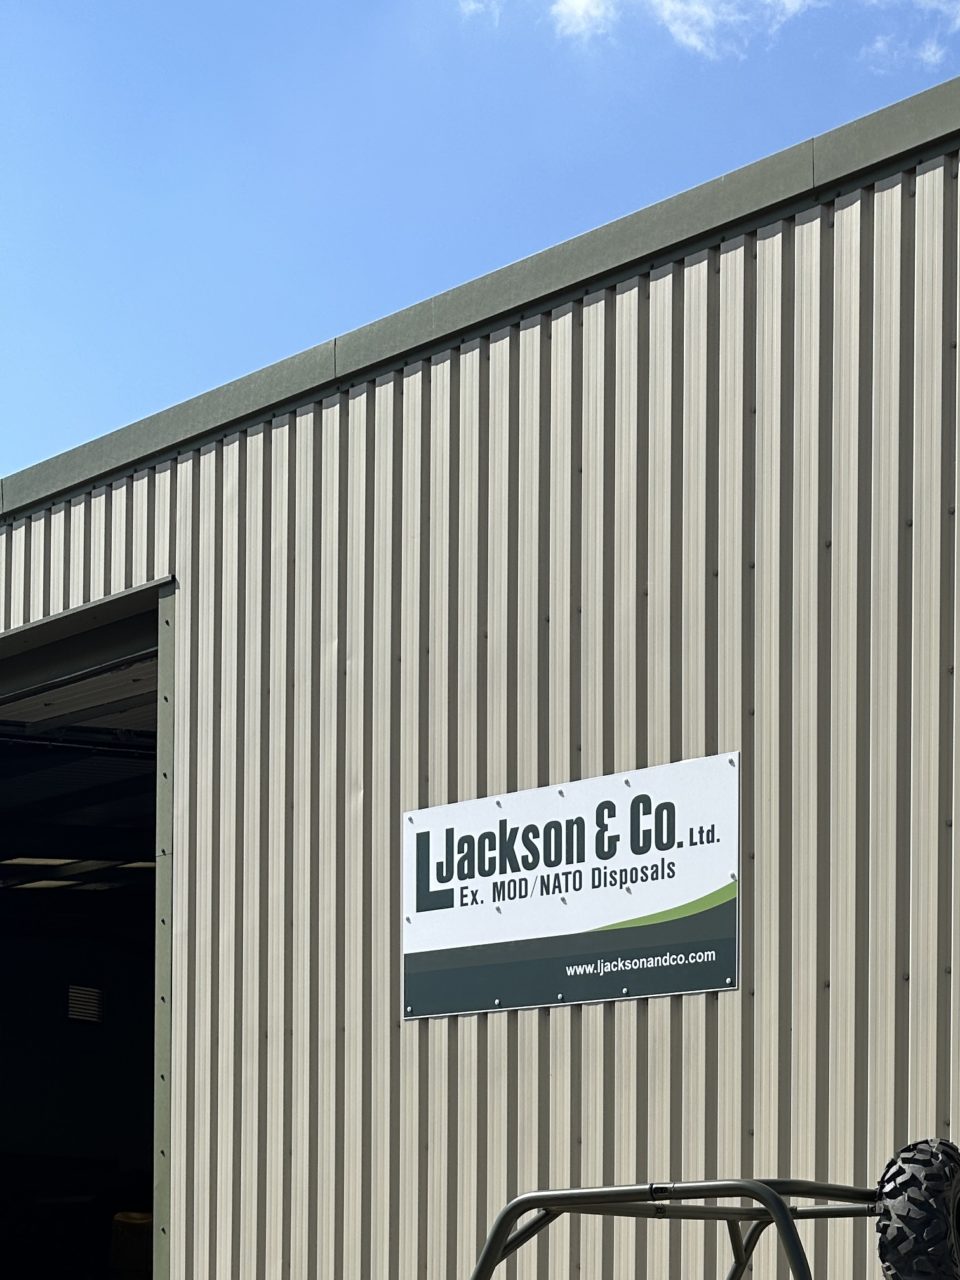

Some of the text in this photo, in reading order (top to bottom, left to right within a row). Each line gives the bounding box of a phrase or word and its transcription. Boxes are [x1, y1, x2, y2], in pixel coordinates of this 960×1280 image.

[595, 800, 620, 861] &
[630, 794, 684, 856] Co.
[689, 824, 720, 847] Ltd.
[460, 857, 676, 907] Ex. MOD/NATO Disposals
[566, 950, 716, 977] www.ljacksonandco.com
